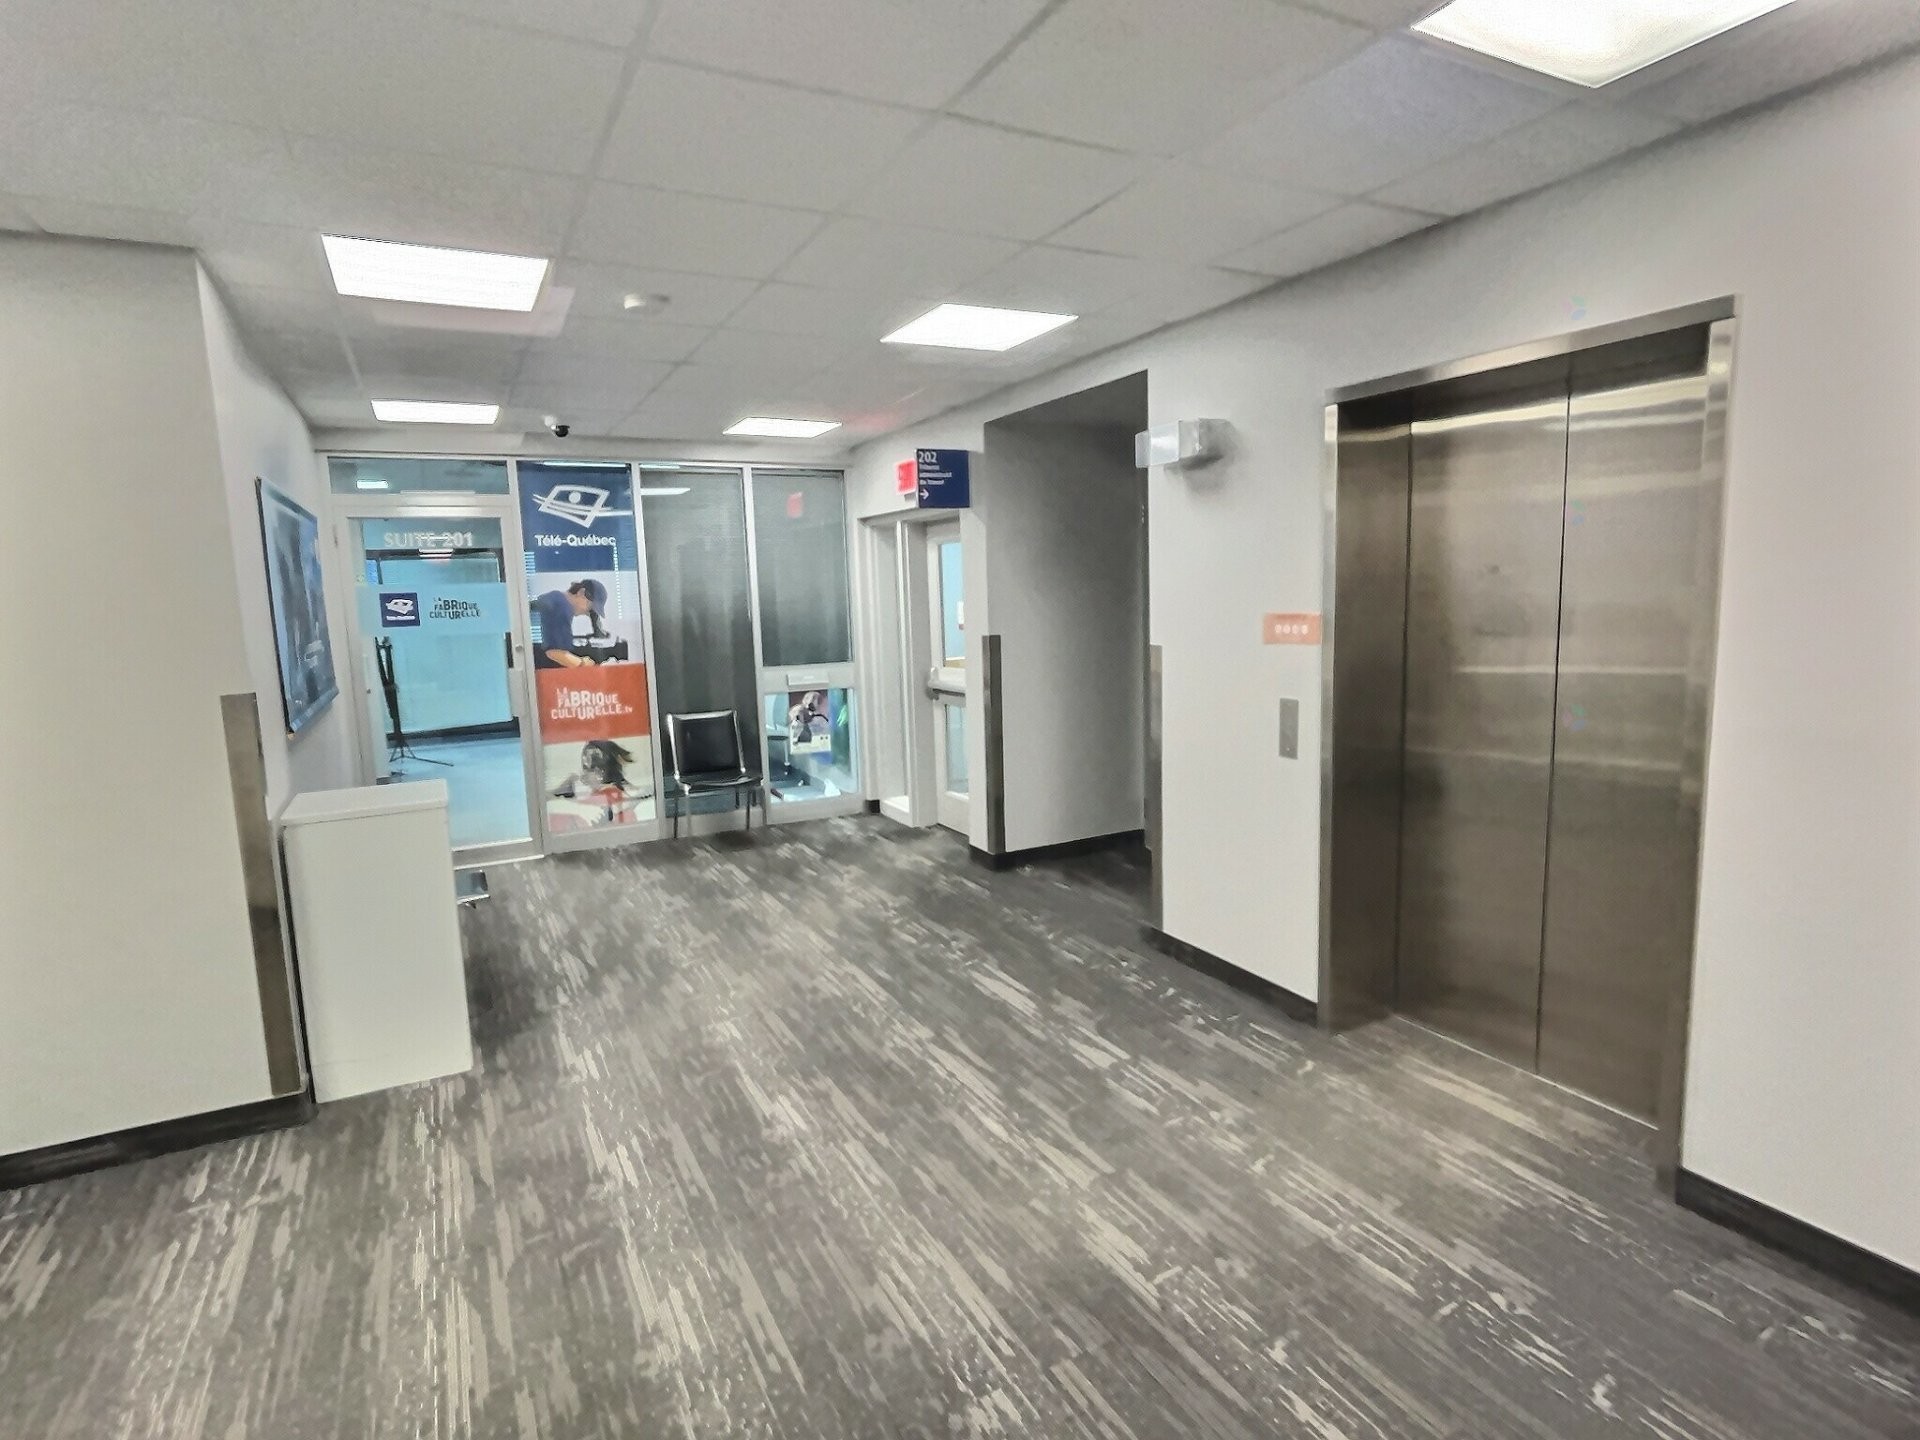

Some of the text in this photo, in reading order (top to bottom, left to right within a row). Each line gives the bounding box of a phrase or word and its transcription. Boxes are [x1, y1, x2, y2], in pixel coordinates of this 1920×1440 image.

[919, 452, 937, 463] 202
[384, 531, 473, 548] SUITE 201
[534, 533, 617, 547] Télé-Québec
[434, 600, 477, 610] FABRIQUE
[430, 609, 480, 619] CULTURELLE
[557, 690, 619, 708] FABRIQUE
